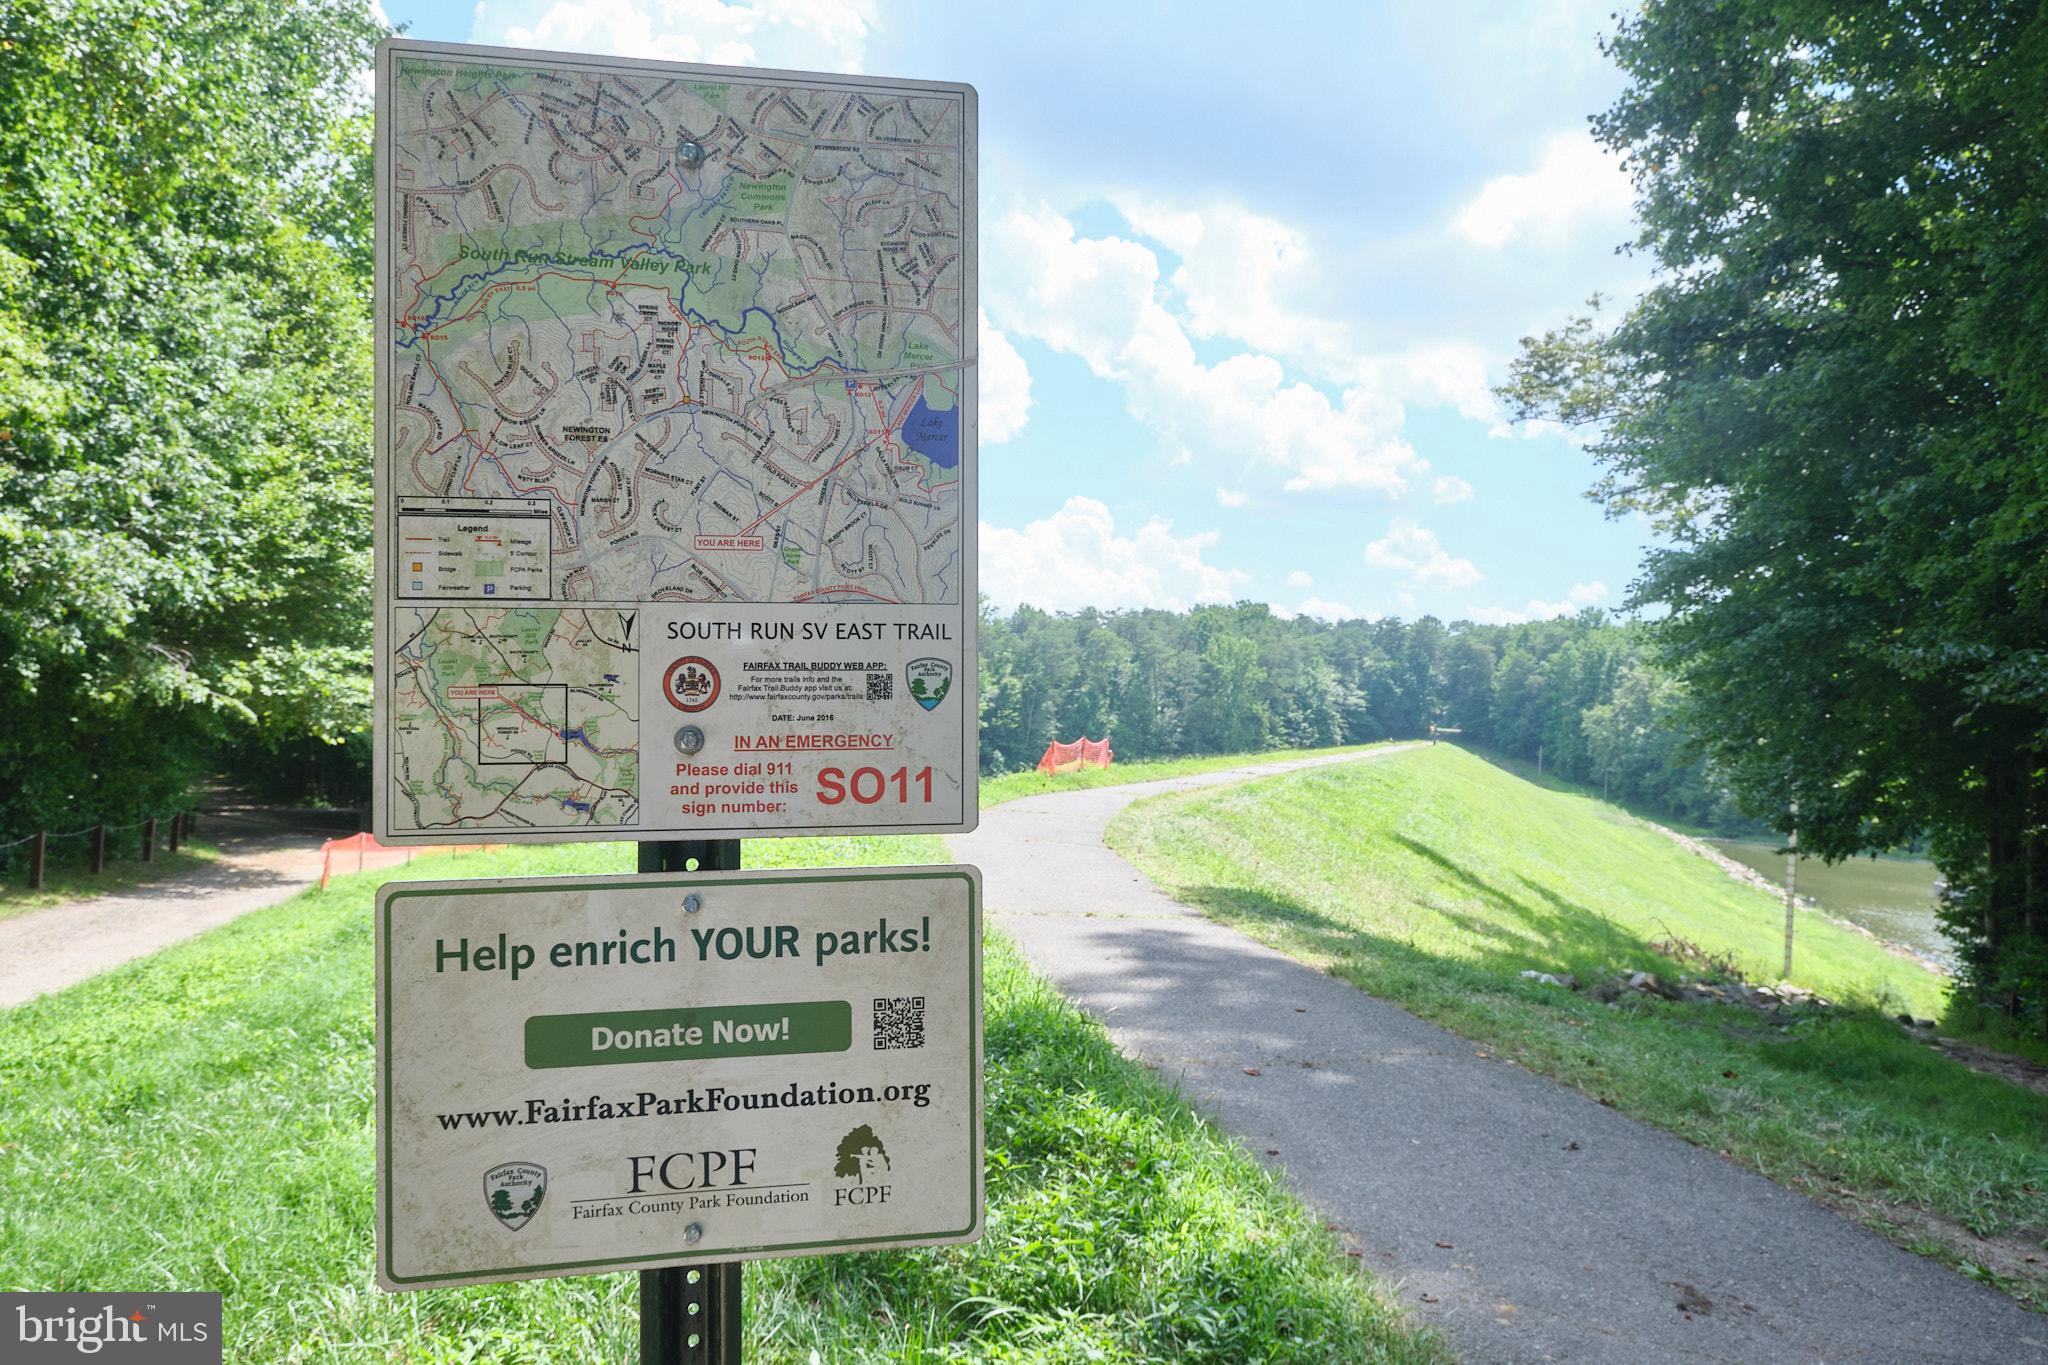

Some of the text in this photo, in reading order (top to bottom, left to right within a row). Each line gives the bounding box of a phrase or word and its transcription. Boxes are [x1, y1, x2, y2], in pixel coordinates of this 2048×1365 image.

[740, 182, 786, 192] Newington
[460, 246, 711, 274] South Run Stream Valley Park
[904, 352, 934, 360] Mercer
[520, 366, 533, 379] GOLD
[702, 410, 732, 422] NEWINGTON
[762, 463, 776, 476] COLD
[776, 473, 791, 486] PLAIN
[458, 525, 488, 533] Legend
[651, 586, 682, 598] GROVELAND
[667, 622, 952, 640] SOUTH RUN SV EAST TRAIL
[622, 643, 631, 653] N
[910, 662, 948, 672] Fairfax County
[780, 684, 802, 693] Buddy
[734, 734, 893, 748] IN AN EMERGENCY
[676, 762, 792, 776] Please dial 911
[670, 780, 798, 798] and provide this
[816, 766, 932, 806] SO11
[682, 800, 786, 817] sign number:
[435, 916, 931, 980] Help enrich YOUR parks!
[592, 1016, 790, 1051] Donate Now!
[438, 1081, 932, 1131] www.FairfaxParkFoundation.org
[490, 1168, 542, 1181] Fairfax County
[626, 1148, 758, 1194] FCPF
[500, 1179, 532, 1187] Authority
[834, 1185, 892, 1206] FCPF
[572, 1190, 809, 1219] Fairfax County Park Foundation
